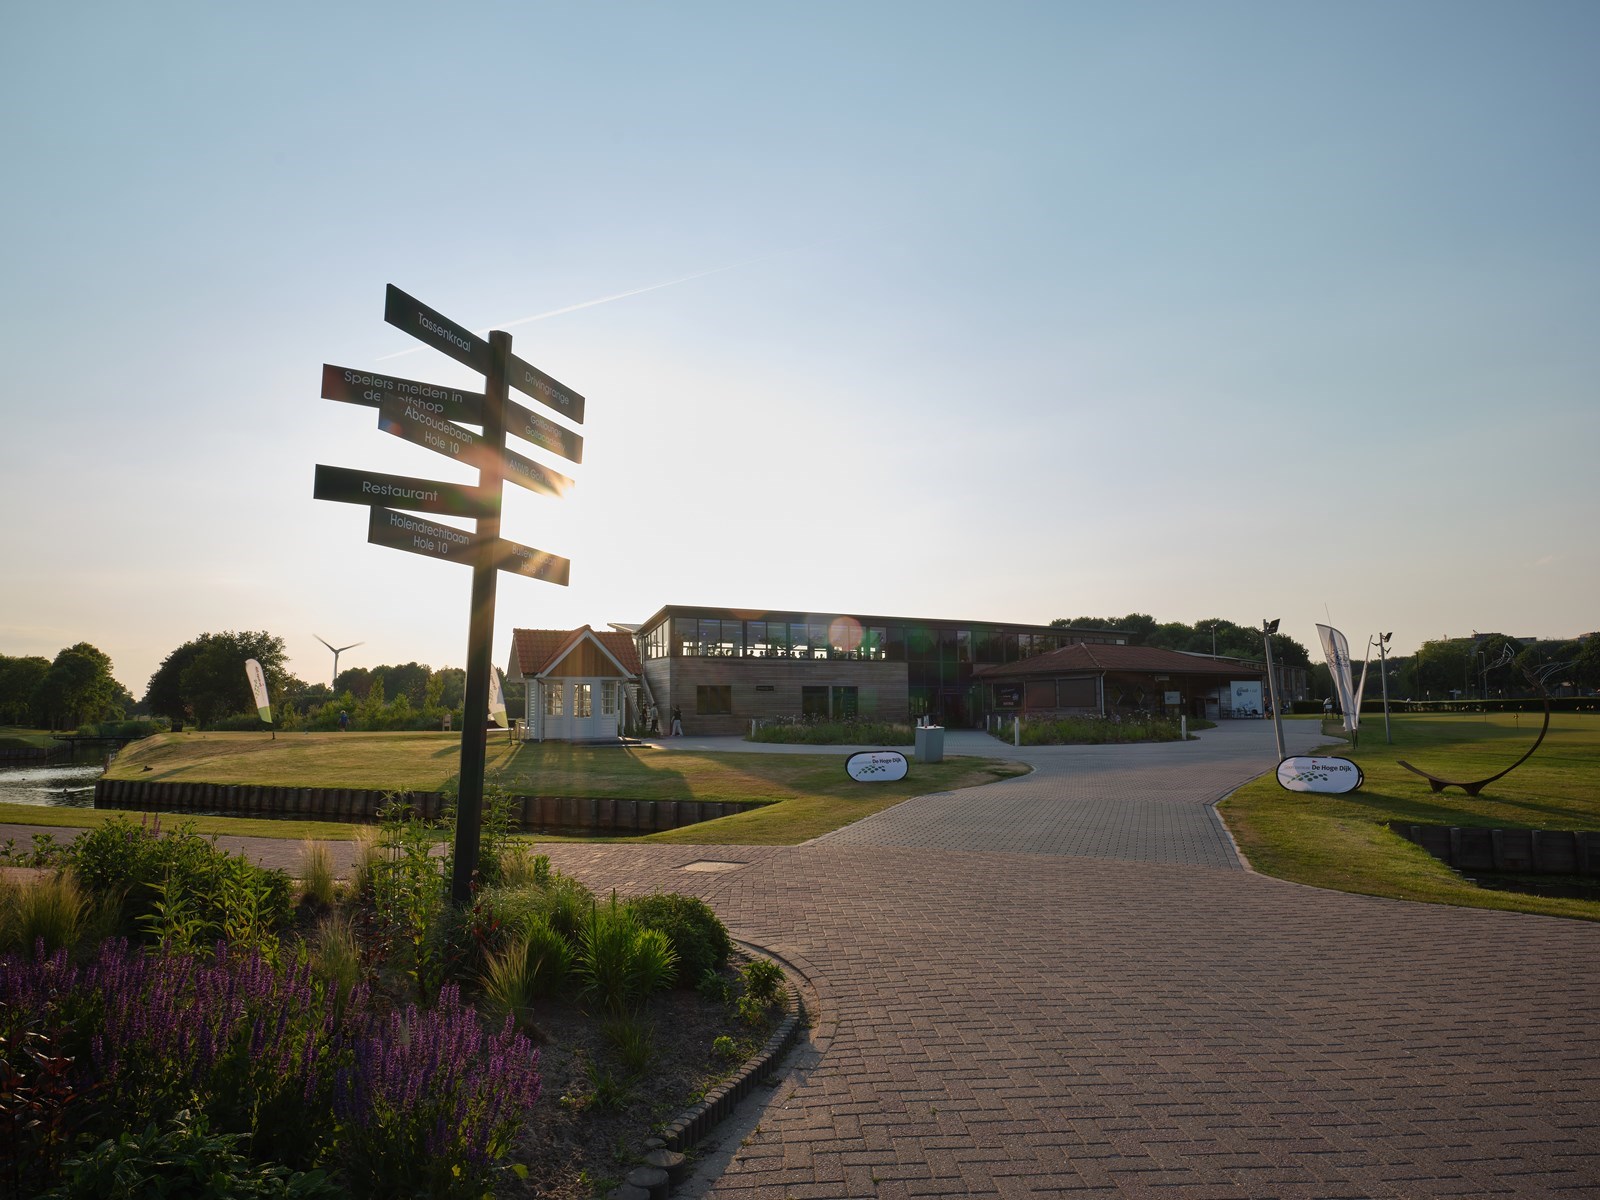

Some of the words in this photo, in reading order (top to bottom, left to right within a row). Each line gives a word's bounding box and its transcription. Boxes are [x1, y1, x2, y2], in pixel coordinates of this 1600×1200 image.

[418, 312, 471, 352] Tassenkraal
[344, 370, 394, 390] Spelers
[397, 382, 448, 400] melden
[452, 391, 463, 403] in
[525, 371, 570, 405] Drivingrange
[363, 390, 381, 402] de
[389, 394, 444, 414] lfshop
[404, 406, 473, 444] Abcoudebaan
[424, 431, 446, 449] Hole
[449, 442, 460, 454] 10
[362, 481, 439, 502] Restaurant
[390, 513, 470, 545] Holendrechtbaan
[413, 535, 435, 551] Hole
[438, 541, 448, 554] 10
[1321, 764, 1338, 772] Hoge
